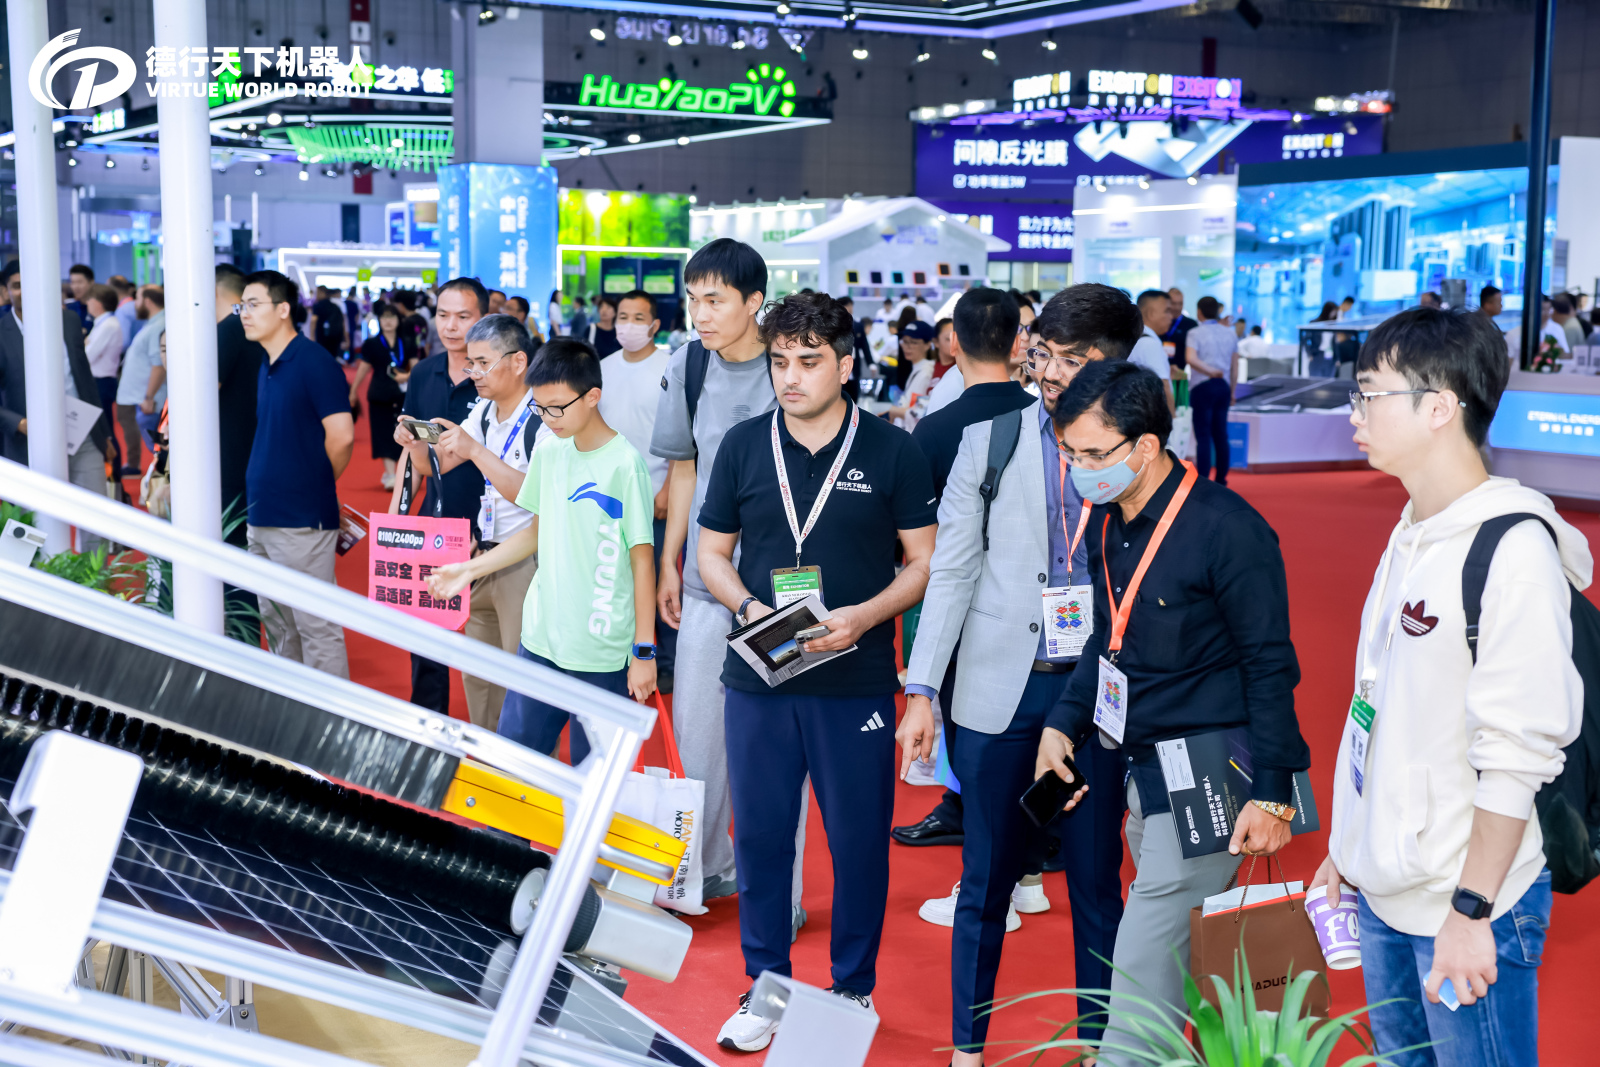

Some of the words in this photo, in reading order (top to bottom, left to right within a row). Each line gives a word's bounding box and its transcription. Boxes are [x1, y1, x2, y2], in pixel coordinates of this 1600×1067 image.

[579, 73, 780, 115] HuaYaoPV
[378, 530, 424, 547] 8100/2400pa
[375, 559, 413, 580] 高安全
[588, 519, 620, 635] YOUNG
[375, 585, 413, 606] 高适配
